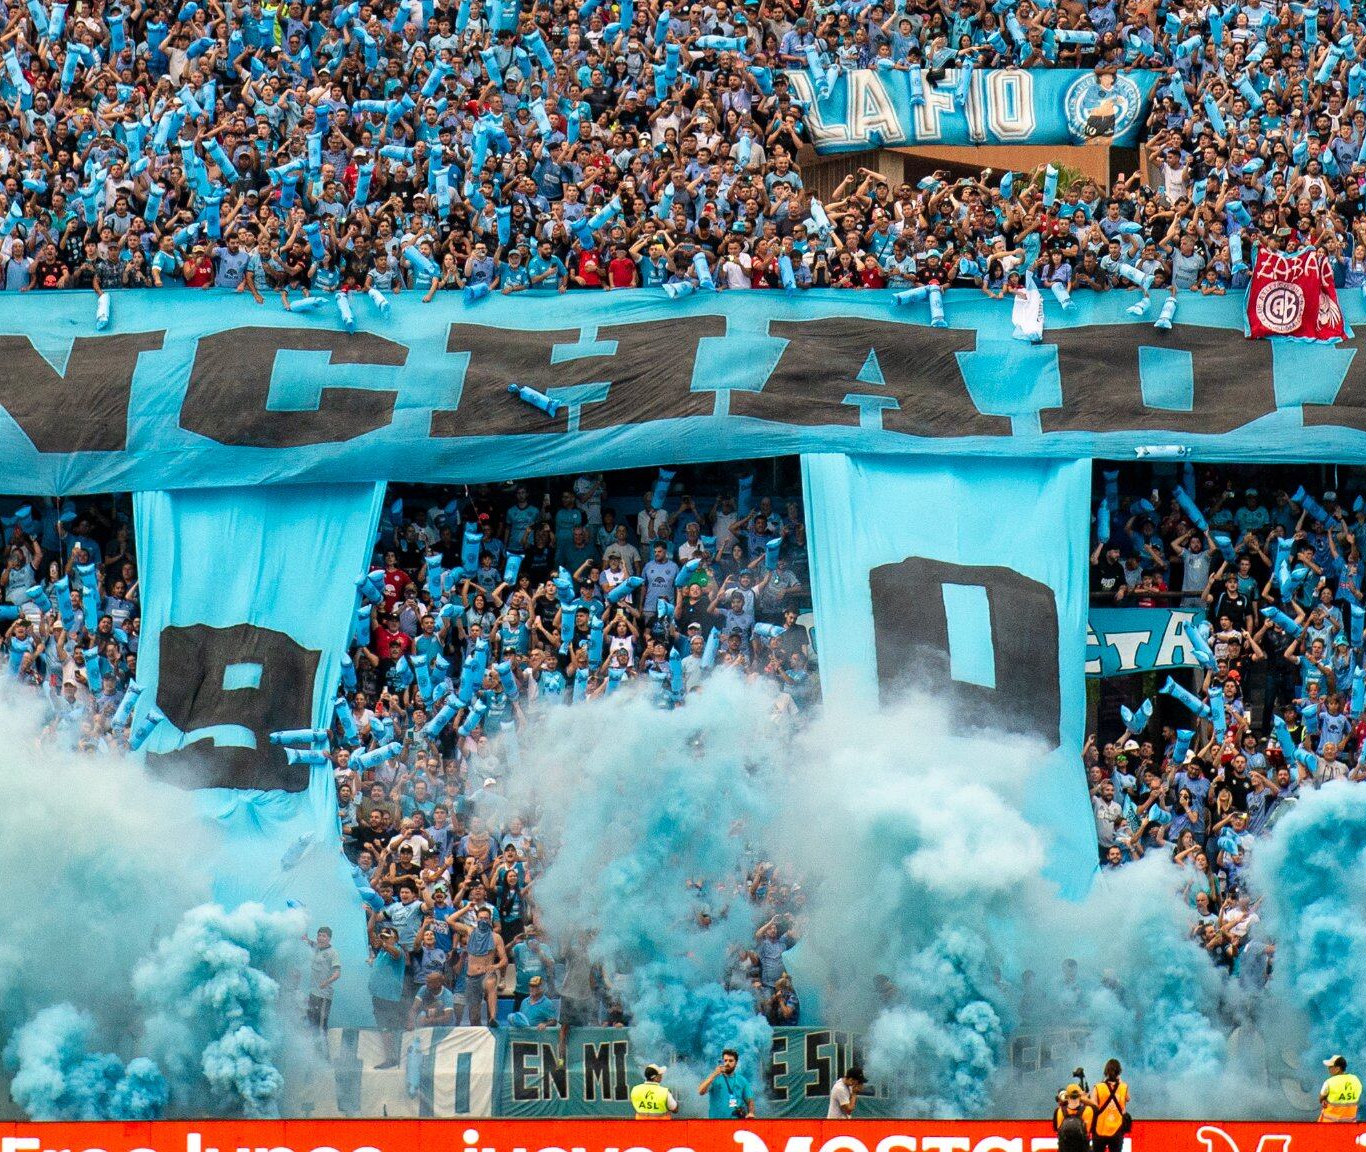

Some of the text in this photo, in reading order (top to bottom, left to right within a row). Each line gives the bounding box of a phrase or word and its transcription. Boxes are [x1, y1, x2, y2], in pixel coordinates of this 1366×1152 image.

[1256, 247, 1334, 287] ZABAA
[146, 622, 322, 793] 9
[511, 1040, 570, 1101] EN
[582, 1040, 631, 1101] MI
[638, 1099, 660, 1110] ASL
